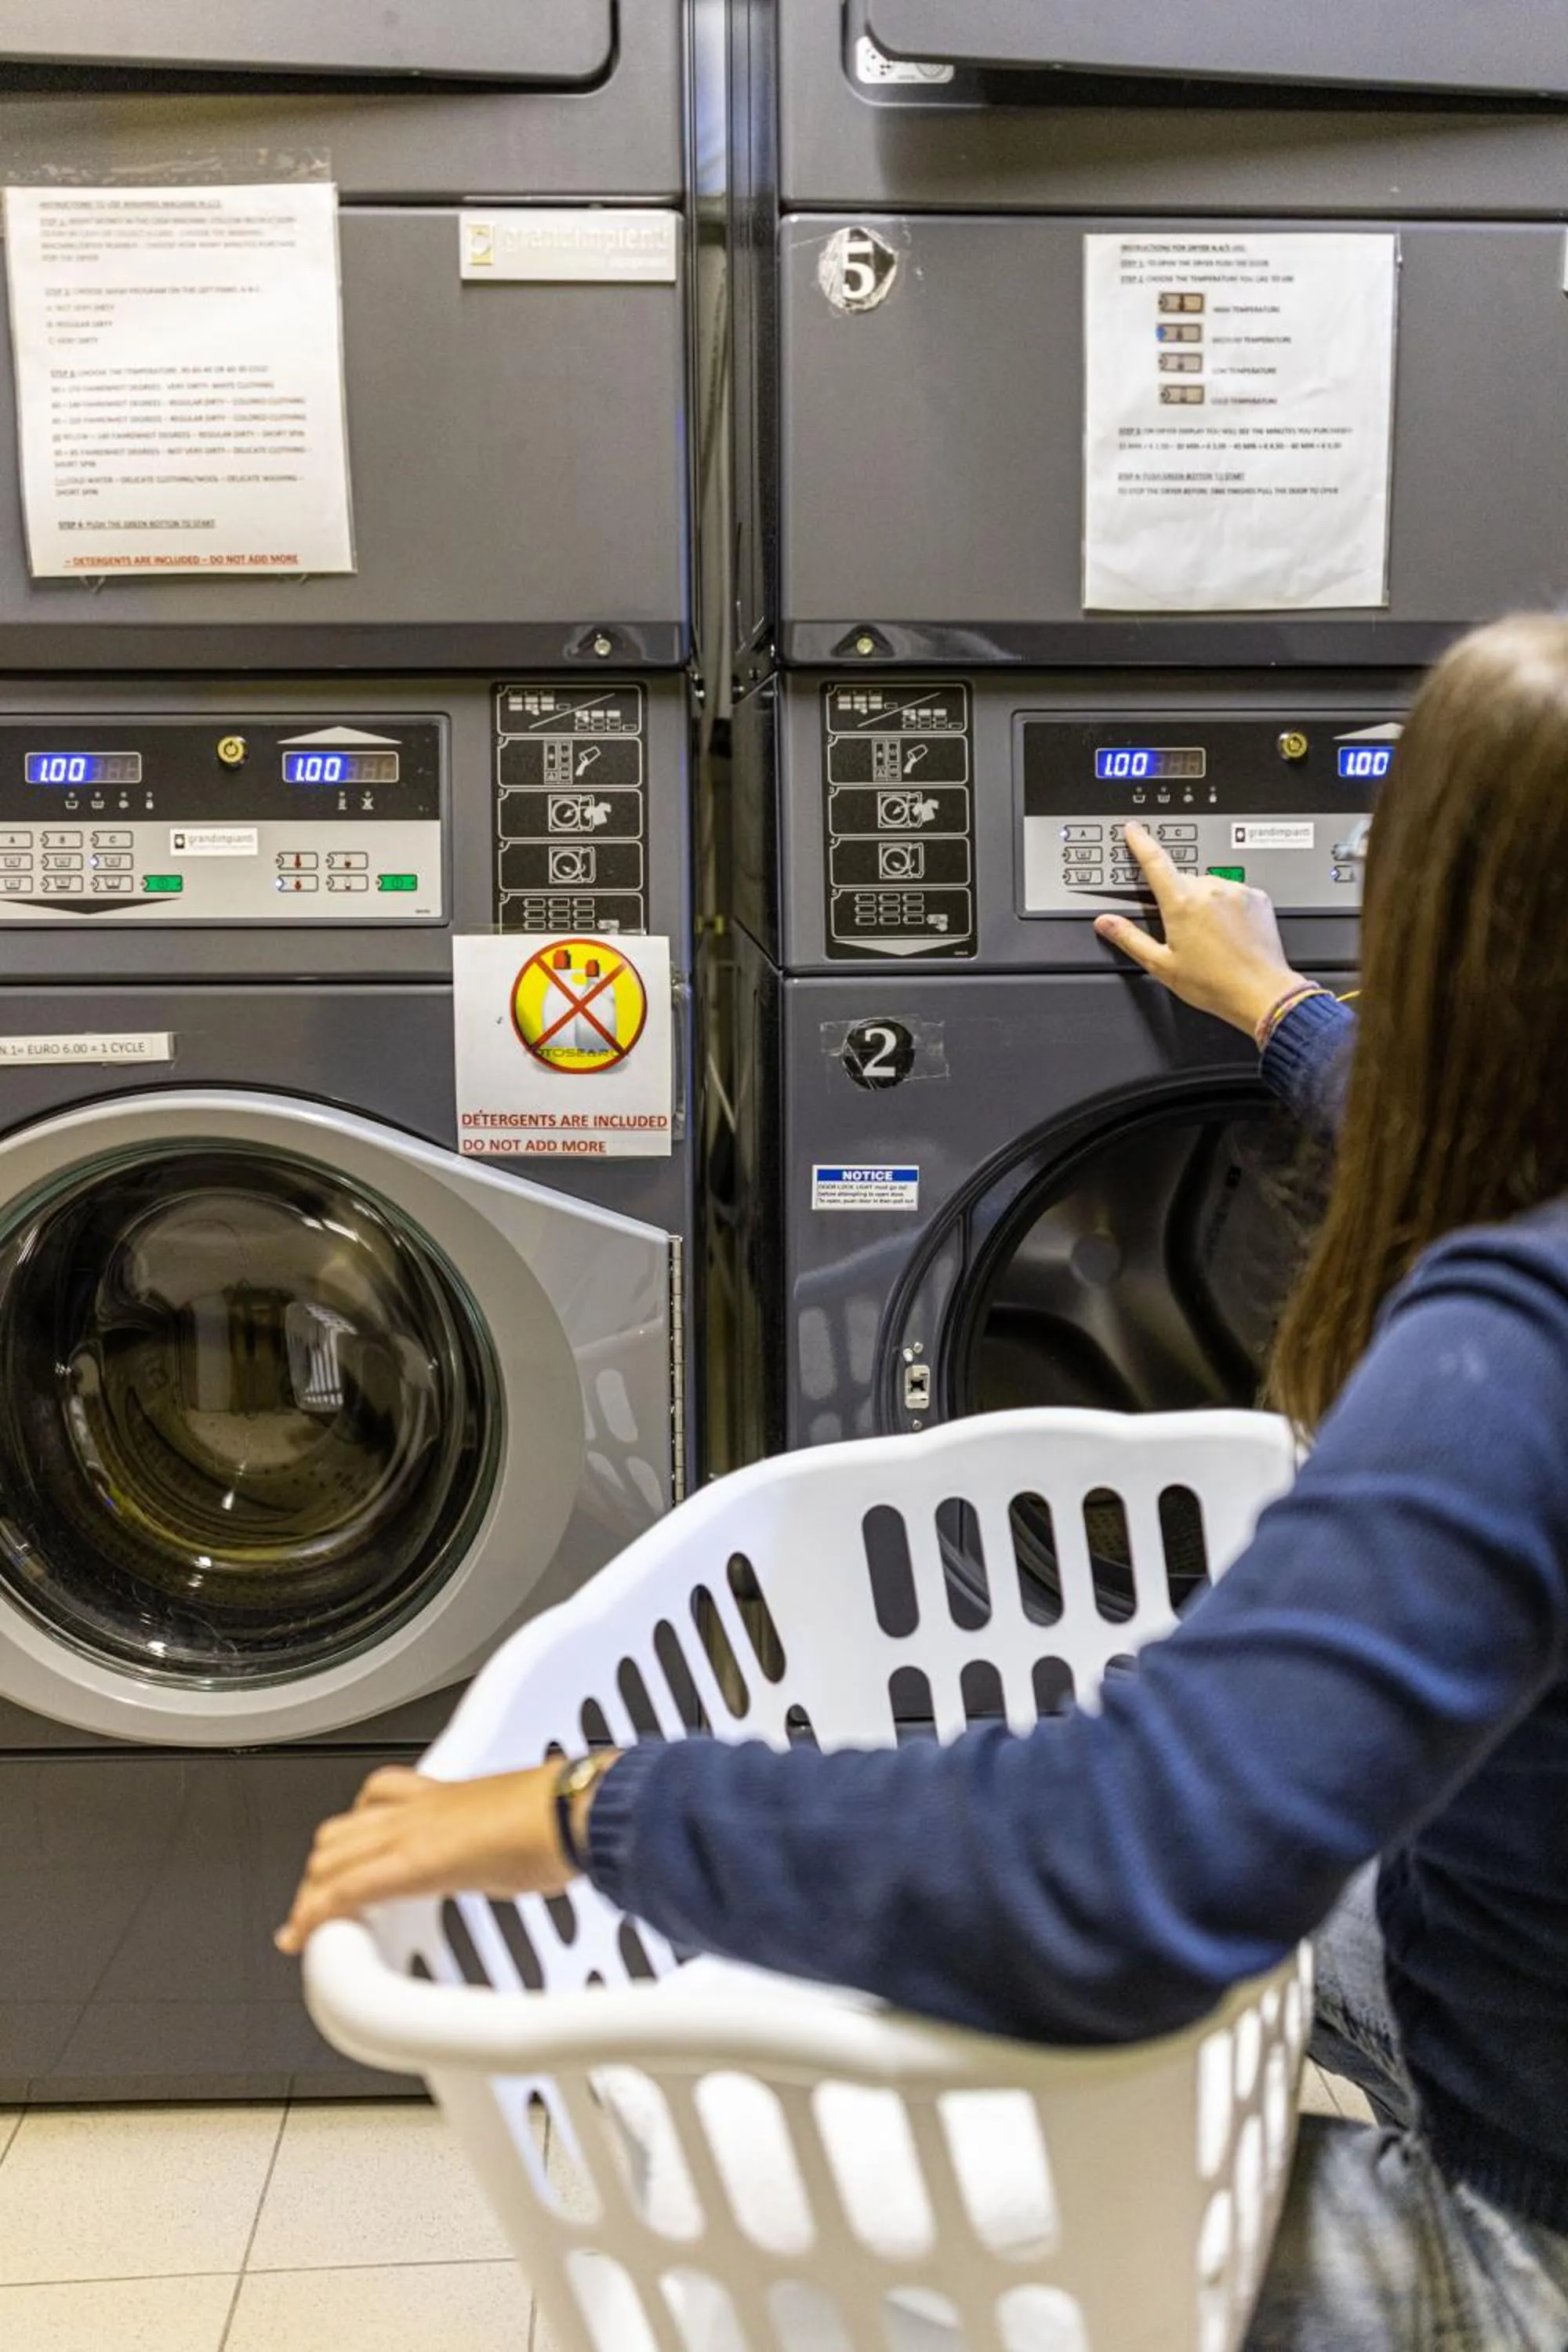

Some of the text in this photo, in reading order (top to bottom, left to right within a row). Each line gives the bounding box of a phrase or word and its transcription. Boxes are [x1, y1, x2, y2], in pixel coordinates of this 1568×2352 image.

[842, 241, 876, 299] 5
[73, 554, 298, 565] DETERGENTS ARE INCLUDED DO NOT ADD MORE
[27, 1044, 60, 1054] EURO
[63, 1044, 88, 1054] 6.00
[111, 1041, 146, 1053] CYCLE
[862, 1028, 897, 1077] 2
[462, 1114, 667, 1127] DETERGENTS ARE INCLUDED
[463, 1139, 606, 1152] DO NOT ADD MORE
[843, 1171, 893, 1181] NOTICE
